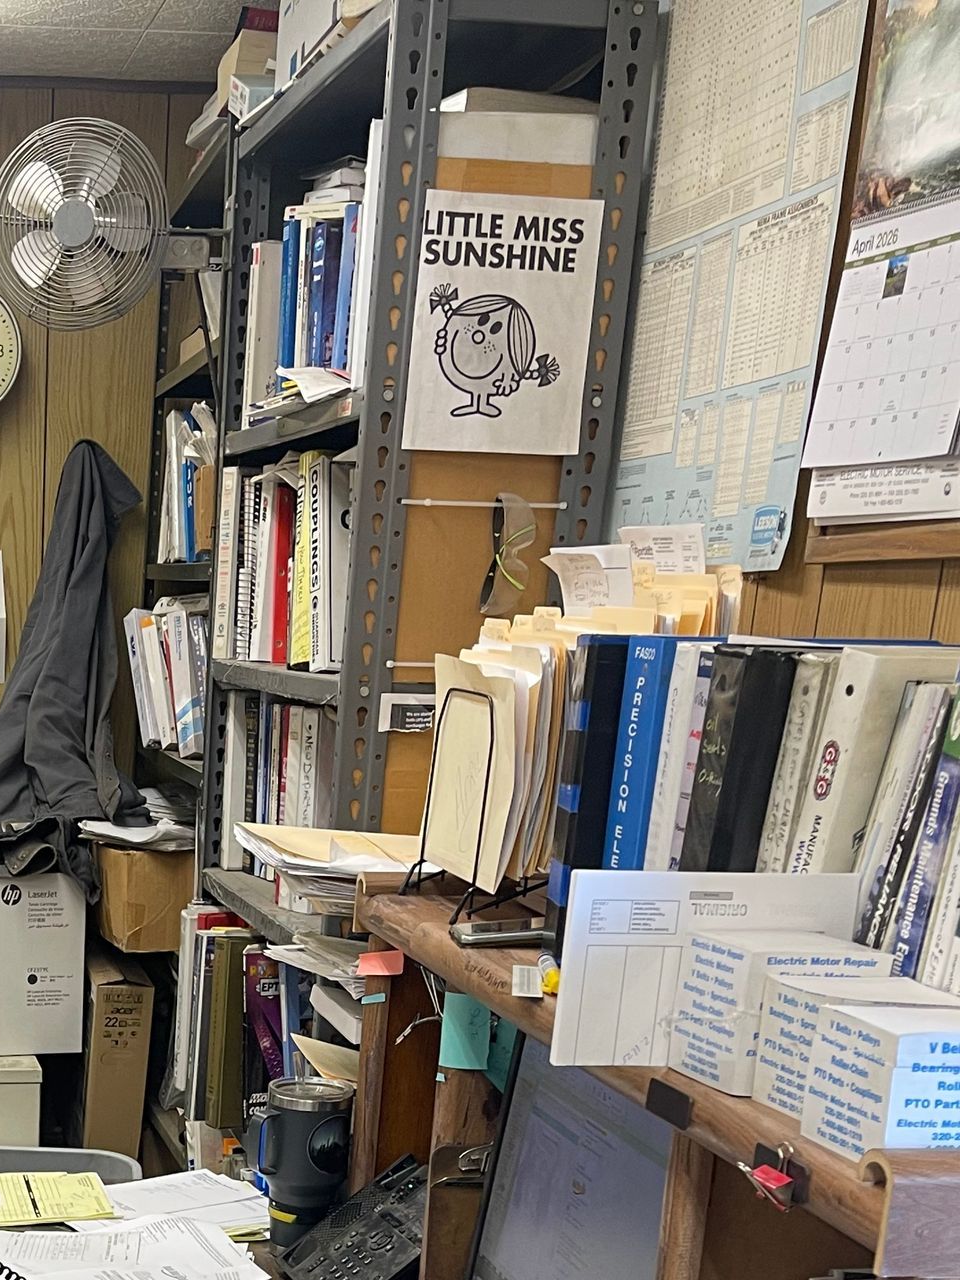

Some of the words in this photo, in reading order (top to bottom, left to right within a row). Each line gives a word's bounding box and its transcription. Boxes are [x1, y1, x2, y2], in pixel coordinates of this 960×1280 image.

[424, 210, 504, 239] LITTLE
[513, 215, 585, 244] MISS
[852, 238, 874, 256] April
[876, 228, 899, 249] 2026
[424, 239, 577, 273] SUNSHINE
[309, 469, 319, 589] COUPLINGS
[635, 646, 656, 660] FASCO
[618, 676, 646, 814] PRECISION
[925, 770, 950, 837] Grounds
[27, 890, 58, 899] LaserJet
[867, 842, 903, 947] RELIANCE
[899, 839, 935, 940] Maintenance
[691, 902, 748, 917] ORIGINAL
[767, 956, 808, 967] Electric
[810, 956, 841, 966] Motor
[843, 957, 878, 969] Repair
[104, 1016, 119, 1028] 22
[110, 1006, 137, 1015] acer
[835, 1022, 852, 1036] Belts
[858, 1029, 881, 1047] Pulleys
[929, 1042, 938, 1054] V
[814, 1066, 827, 1080] PTO
[828, 1072, 845, 1088] Parts
[850, 1082, 882, 1103] Couplings
[904, 1099, 931, 1109] PTO
[896, 1119, 938, 1128] Electric
